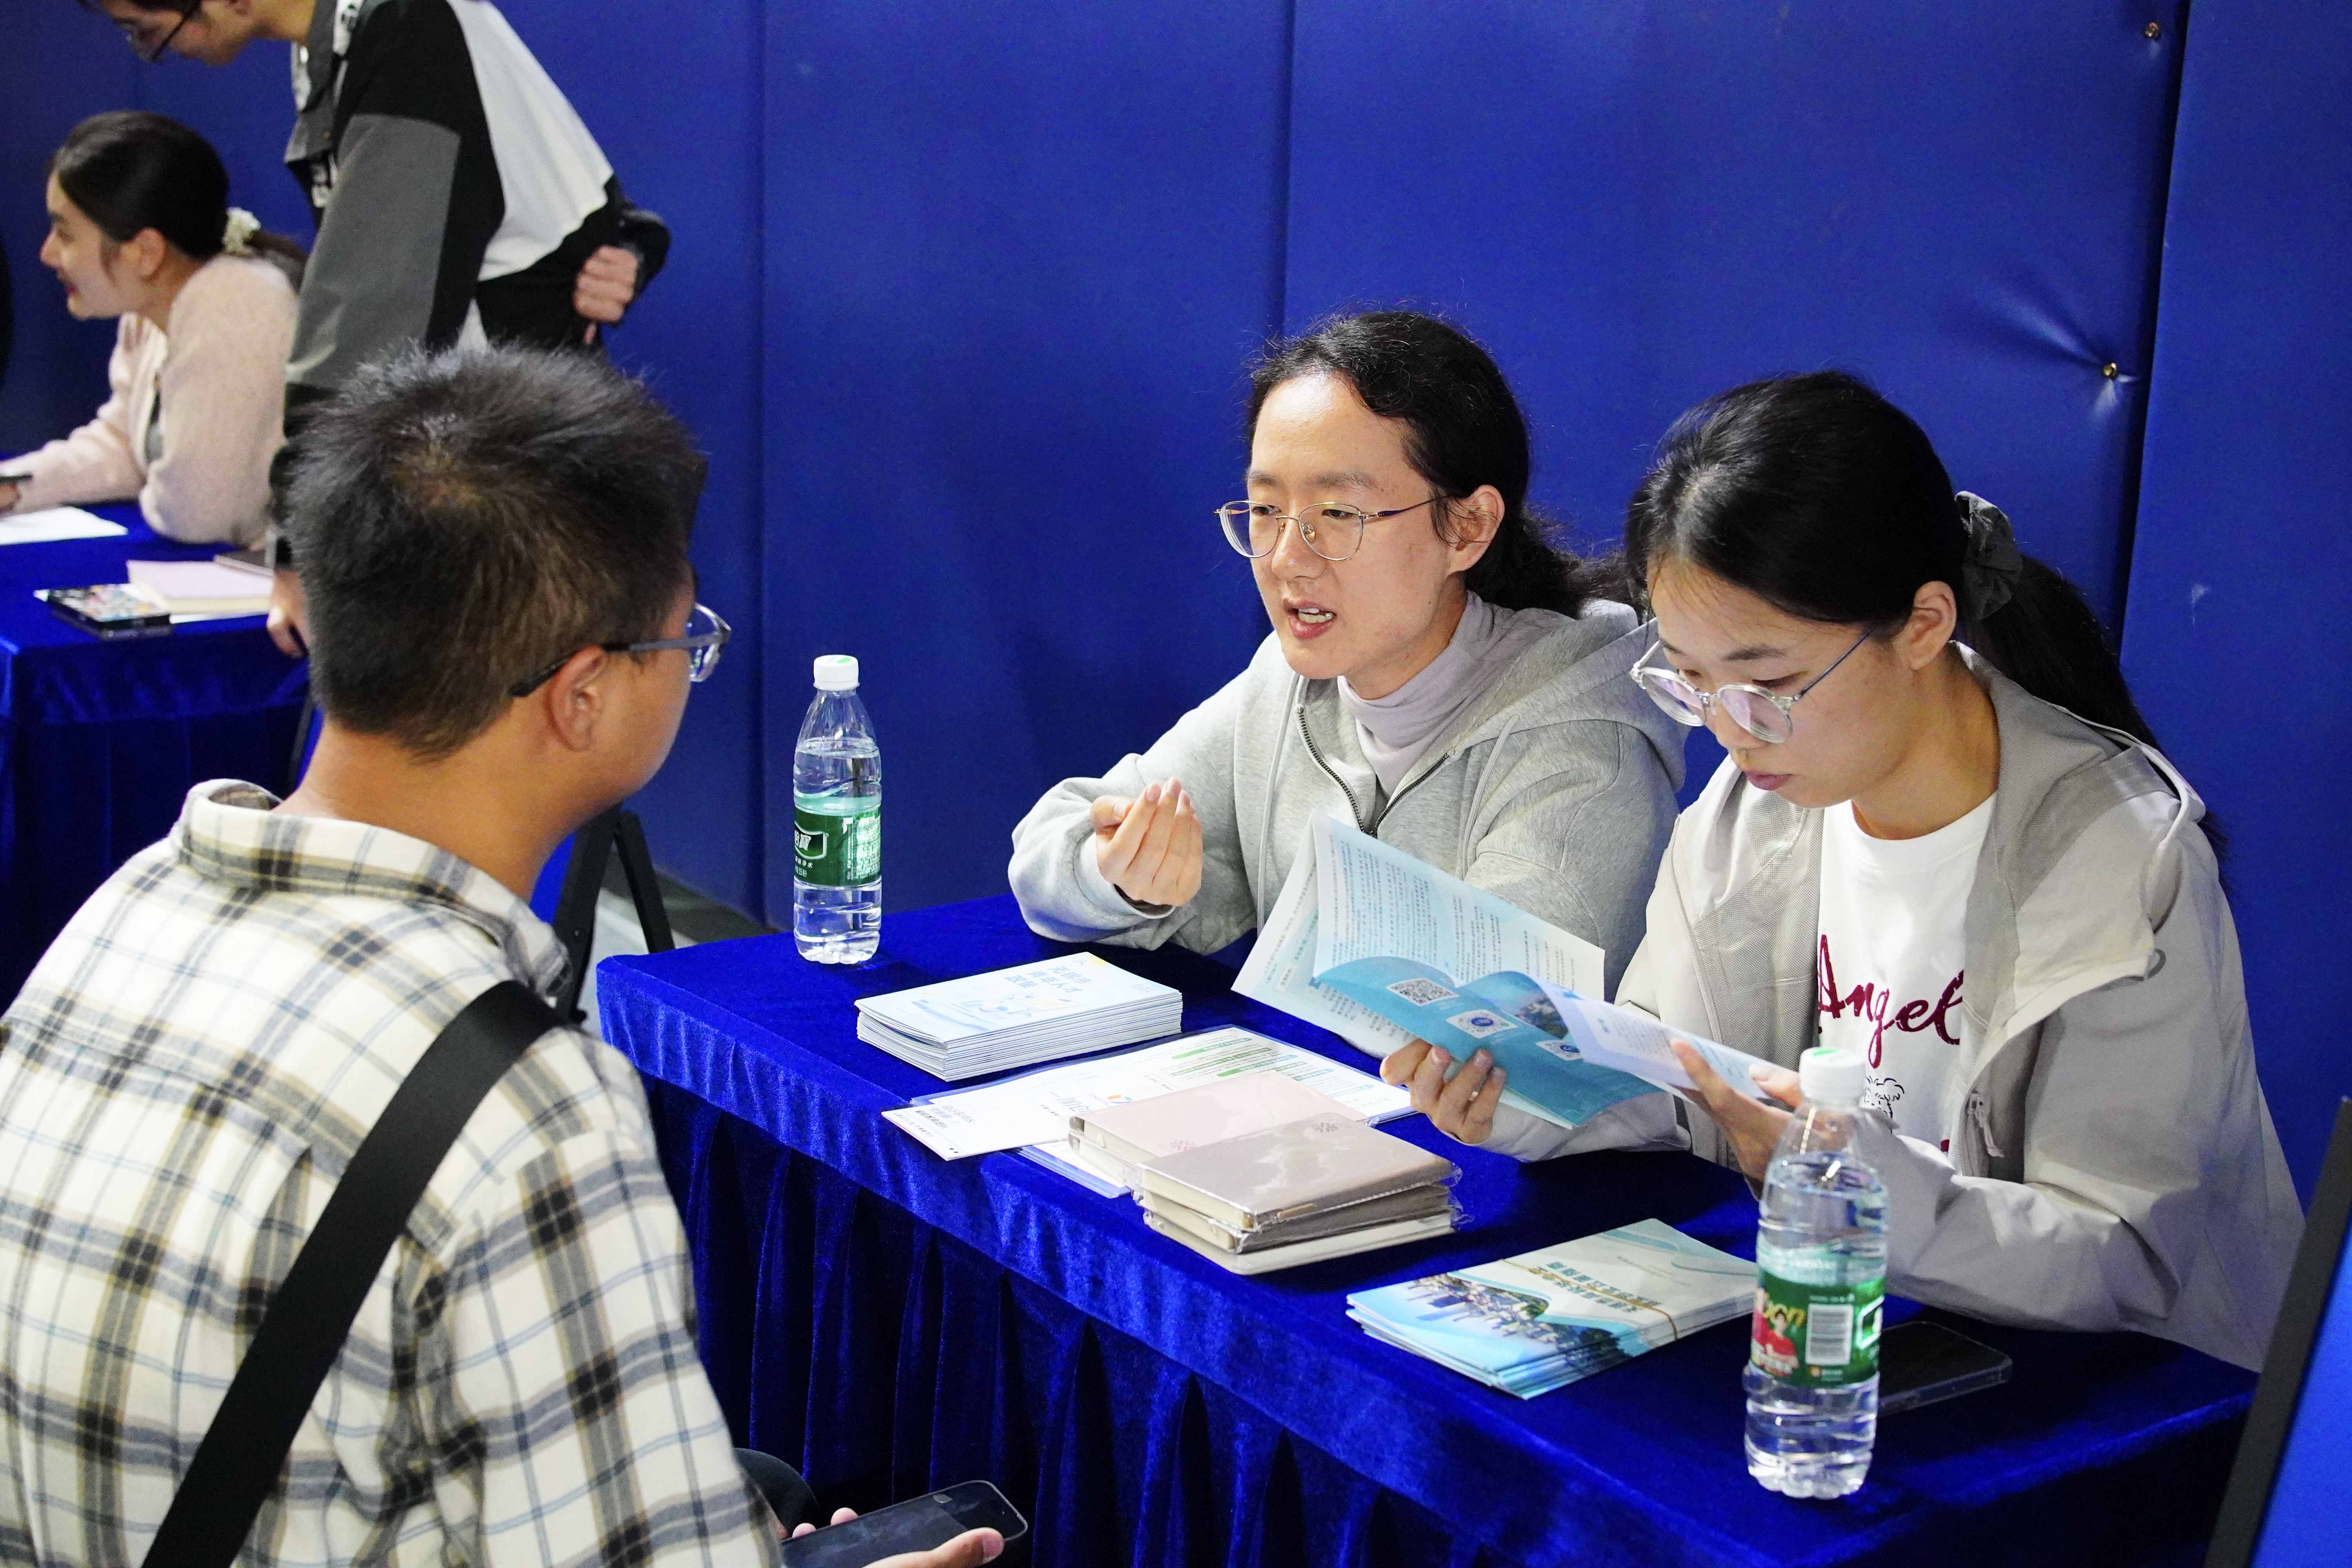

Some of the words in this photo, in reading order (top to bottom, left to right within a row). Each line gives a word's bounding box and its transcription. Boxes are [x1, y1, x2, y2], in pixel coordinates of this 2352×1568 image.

[1004, 975, 1039, 988] 政策
[1027, 970, 1082, 993] 青年人才
[1048, 966, 1093, 984] 无锡市
[1818, 934, 1964, 1068] Angel
